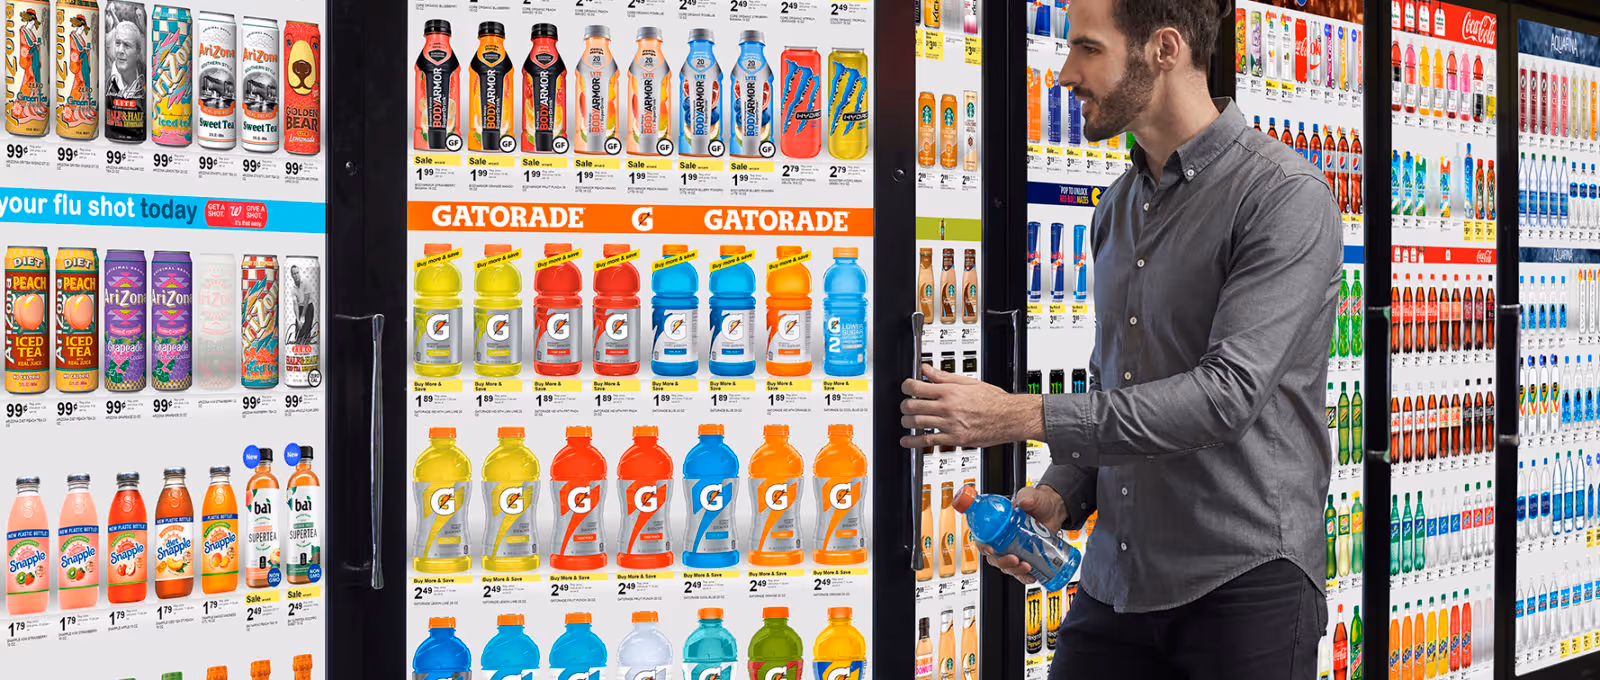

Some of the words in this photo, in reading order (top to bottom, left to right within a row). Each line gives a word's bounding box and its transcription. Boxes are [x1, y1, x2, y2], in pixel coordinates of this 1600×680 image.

[1551, 33, 1578, 57] AQUAFINA
[432, 67, 442, 128] BODYARMOR
[486, 69, 496, 129] BODYARMOR
[540, 70, 549, 130] BODYARMOR
[286, 106, 318, 117] GOLDEN
[592, 78, 600, 133] BODYARMOR
[644, 79, 653, 134] BODYARMOR
[696, 80, 704, 136] BODYARMOR
[746, 82, 755, 136] BODYARMOR
[200, 118, 222, 129] Sweet
[243, 121, 266, 132] Sweet
[286, 116, 318, 132] BEAR
[7, 144, 28, 158] 99¢
[58, 148, 78, 161] 99¢
[106, 151, 126, 164] 99¢
[154, 154, 172, 166] 99¢
[199, 156, 218, 170] 99¢
[243, 159, 261, 172] 99¢
[415, 156, 432, 164] Sale
[286, 162, 303, 175] 99¢
[0, 196, 48, 218] your
[53, 193, 81, 216] flu
[88, 195, 135, 218] shot
[140, 197, 197, 224] today
[432, 204, 584, 228] GATORADE
[632, 206, 654, 230] G
[704, 209, 848, 232] GATORADE
[13, 257, 43, 268] DIET
[63, 257, 93, 269] DIET
[416, 259, 427, 268] Buy
[428, 256, 440, 264] more
[12, 276, 47, 290] PEACH
[63, 278, 96, 290] PEACH
[426, 314, 450, 341] G
[664, 314, 687, 340] G
[778, 314, 800, 341] G
[16, 336, 44, 346] ICED
[66, 336, 93, 346] ICED
[829, 337, 840, 352] 2
[17, 346, 42, 358] TEA
[68, 346, 92, 357] TEA
[106, 400, 126, 414] 99¢
[154, 399, 172, 412] 99¢
[242, 396, 260, 410] 99¢
[286, 395, 302, 408] 99¢
[6, 404, 28, 417] 99¢
[58, 402, 78, 416] 99¢
[430, 488, 455, 516] G
[700, 484, 723, 511] G
[830, 483, 852, 510] G
[254, 498, 272, 514] bai
[295, 496, 312, 512] bai
[248, 530, 277, 543] SUPERTEA
[289, 528, 318, 540] SUPERTEA
[157, 539, 192, 560] Snapple
[166, 538, 178, 548] diet
[204, 533, 236, 554] Snapple
[61, 546, 96, 568] Snapple
[110, 544, 144, 564] Snapple
[10, 551, 46, 572] Snapple
[246, 594, 261, 604] Sale
[288, 590, 302, 599] Sale
